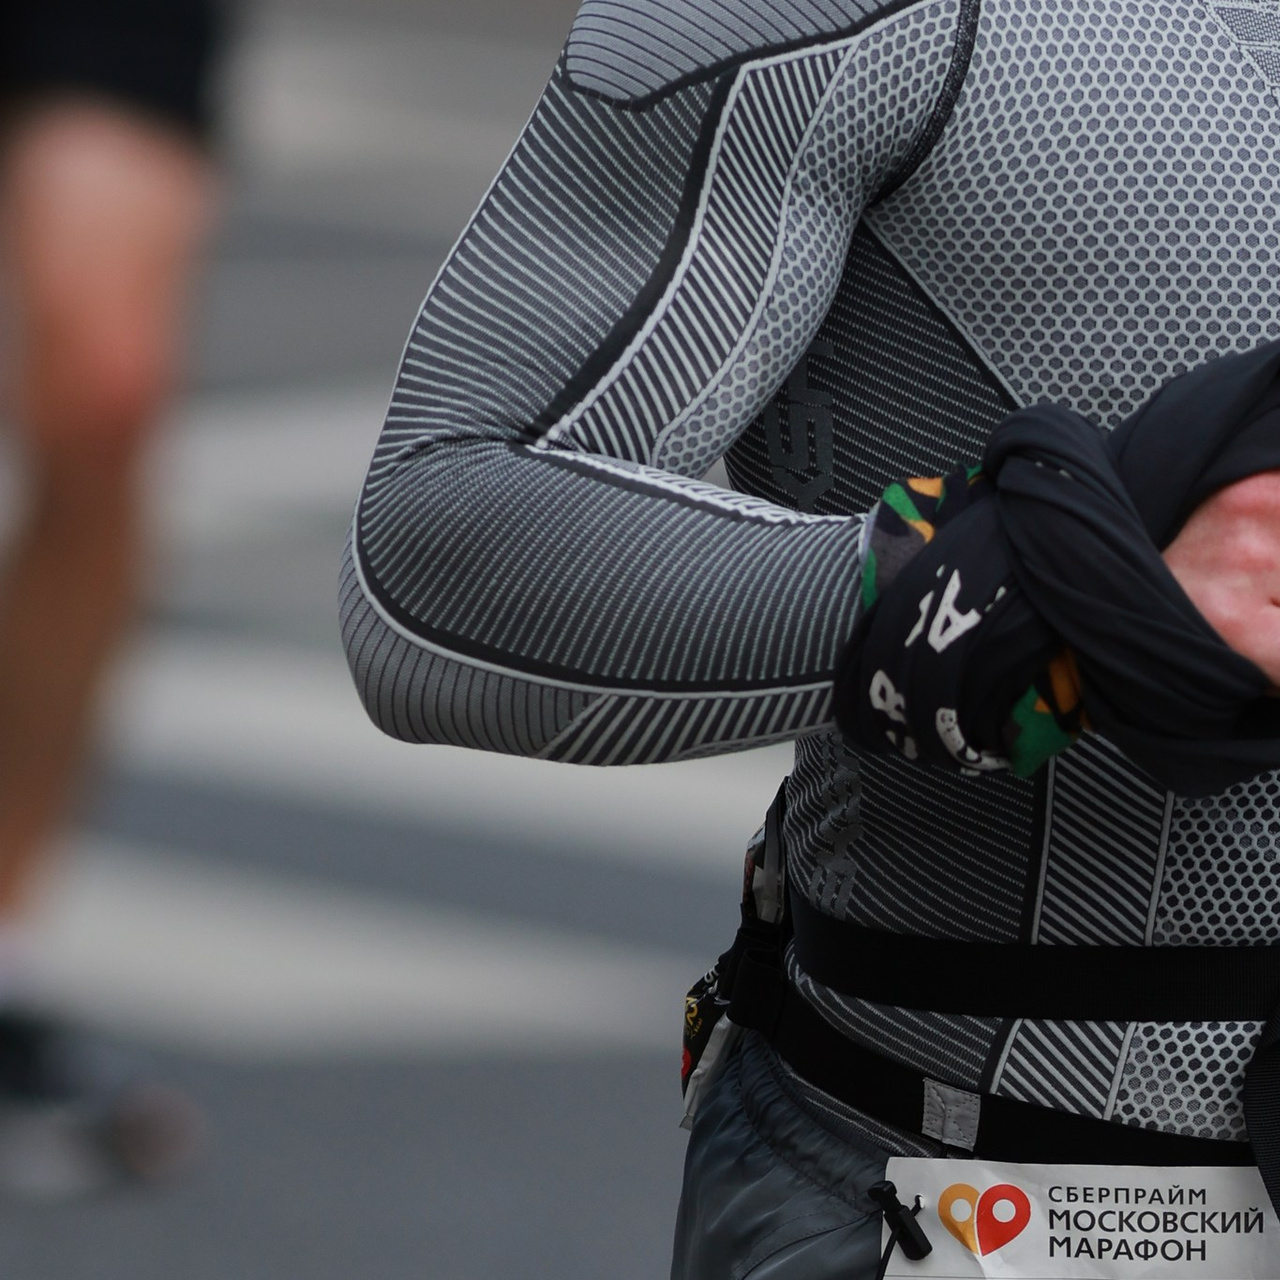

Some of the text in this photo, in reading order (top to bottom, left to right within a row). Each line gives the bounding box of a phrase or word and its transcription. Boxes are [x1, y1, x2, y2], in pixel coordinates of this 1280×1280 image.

[1048, 1184, 1207, 1206] СБЕРПРАЙМ
[1048, 1206, 1265, 1234] МОСКОВСКИЙ
[1048, 1236, 1207, 1262] МАРАФОН
